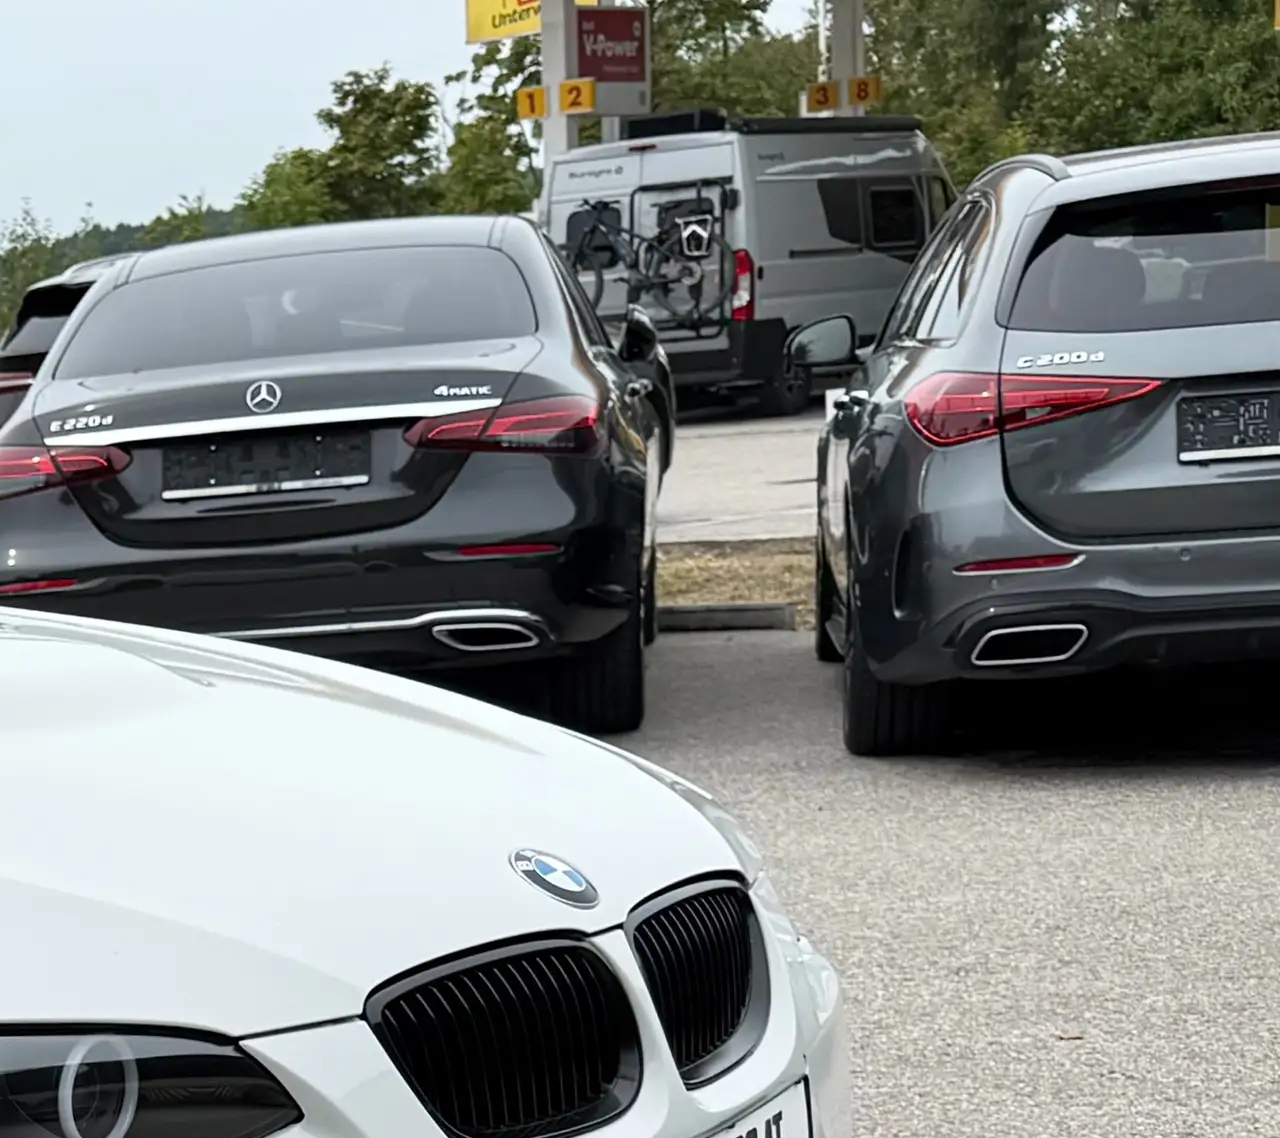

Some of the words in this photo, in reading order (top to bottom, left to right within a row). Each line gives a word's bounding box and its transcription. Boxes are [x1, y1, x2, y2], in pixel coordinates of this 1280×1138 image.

[582, 33, 639, 57] V-Power
[566, 85, 582, 108] 2
[814, 85, 830, 106] 3
[856, 81, 869, 102] 8
[525, 91, 536, 115] 1
[433, 384, 493, 396] 4MATIC
